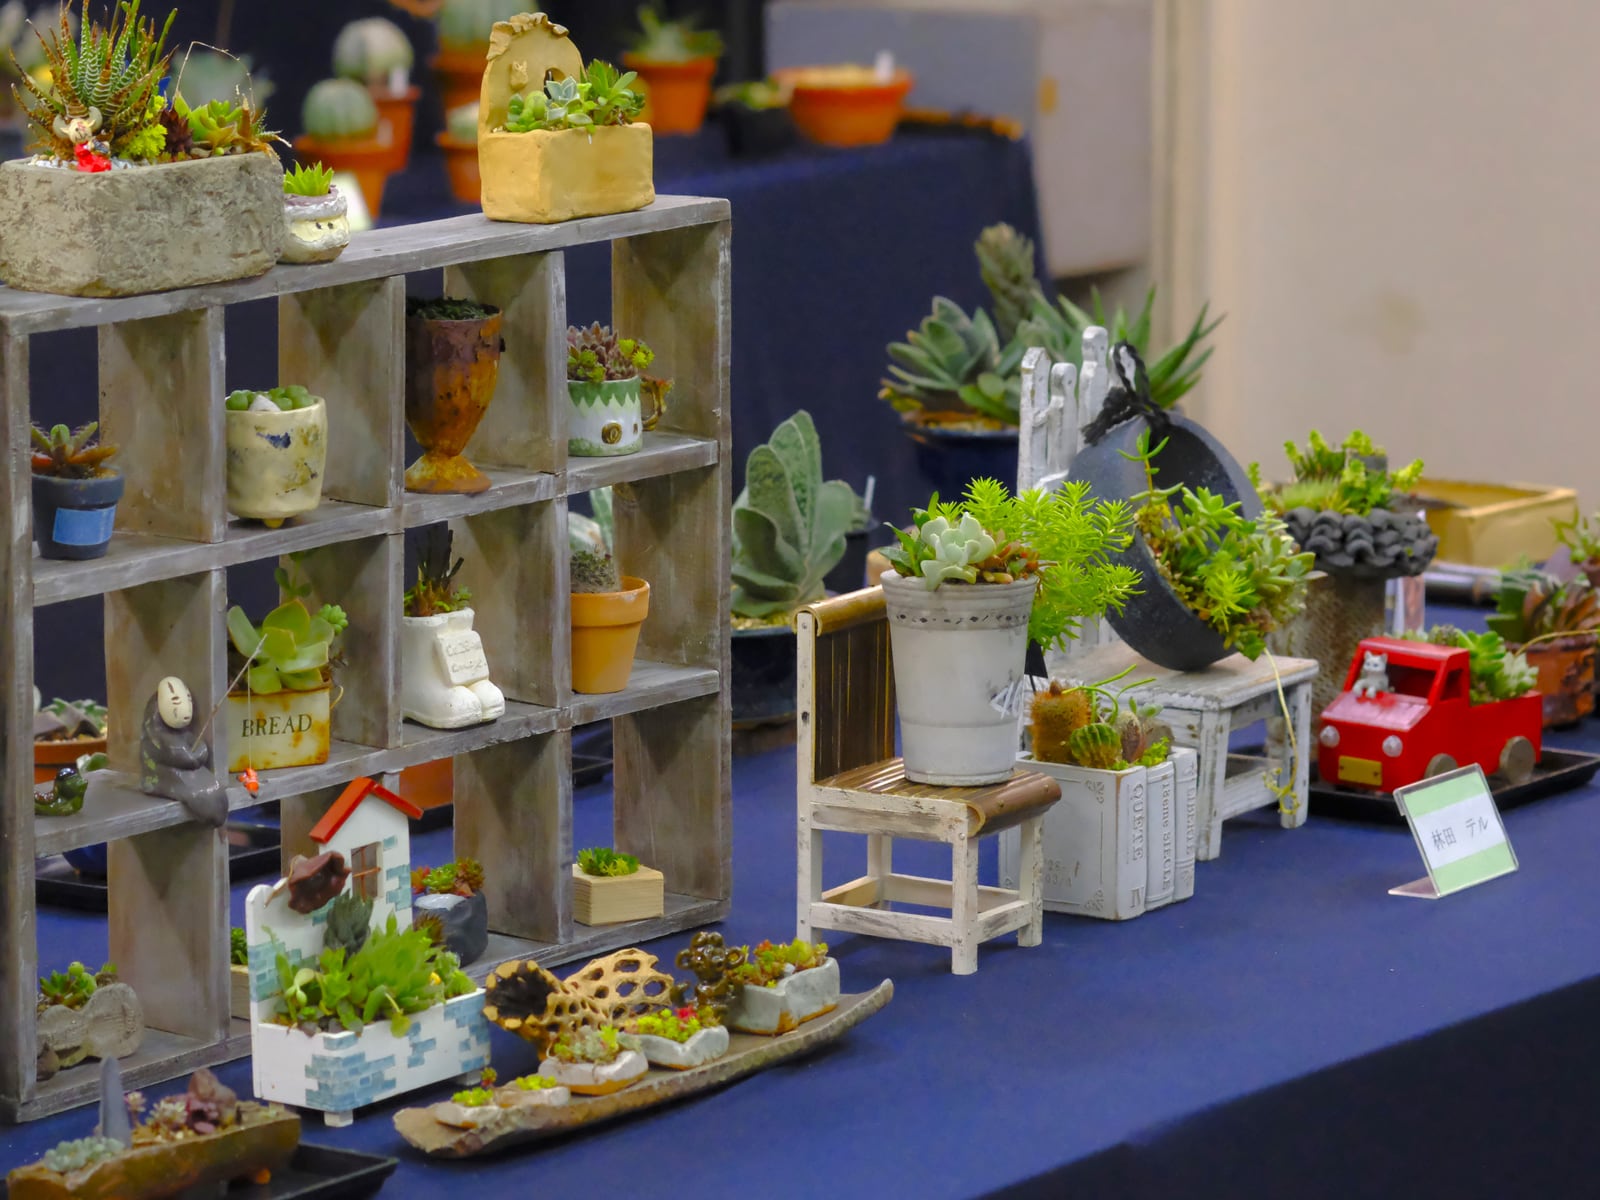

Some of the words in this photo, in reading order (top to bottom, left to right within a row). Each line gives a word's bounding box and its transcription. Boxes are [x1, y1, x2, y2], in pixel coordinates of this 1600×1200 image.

[242, 714, 312, 737] BREAD
[1432, 827, 1457, 850] 林田
[1465, 816, 1489, 838] テル
